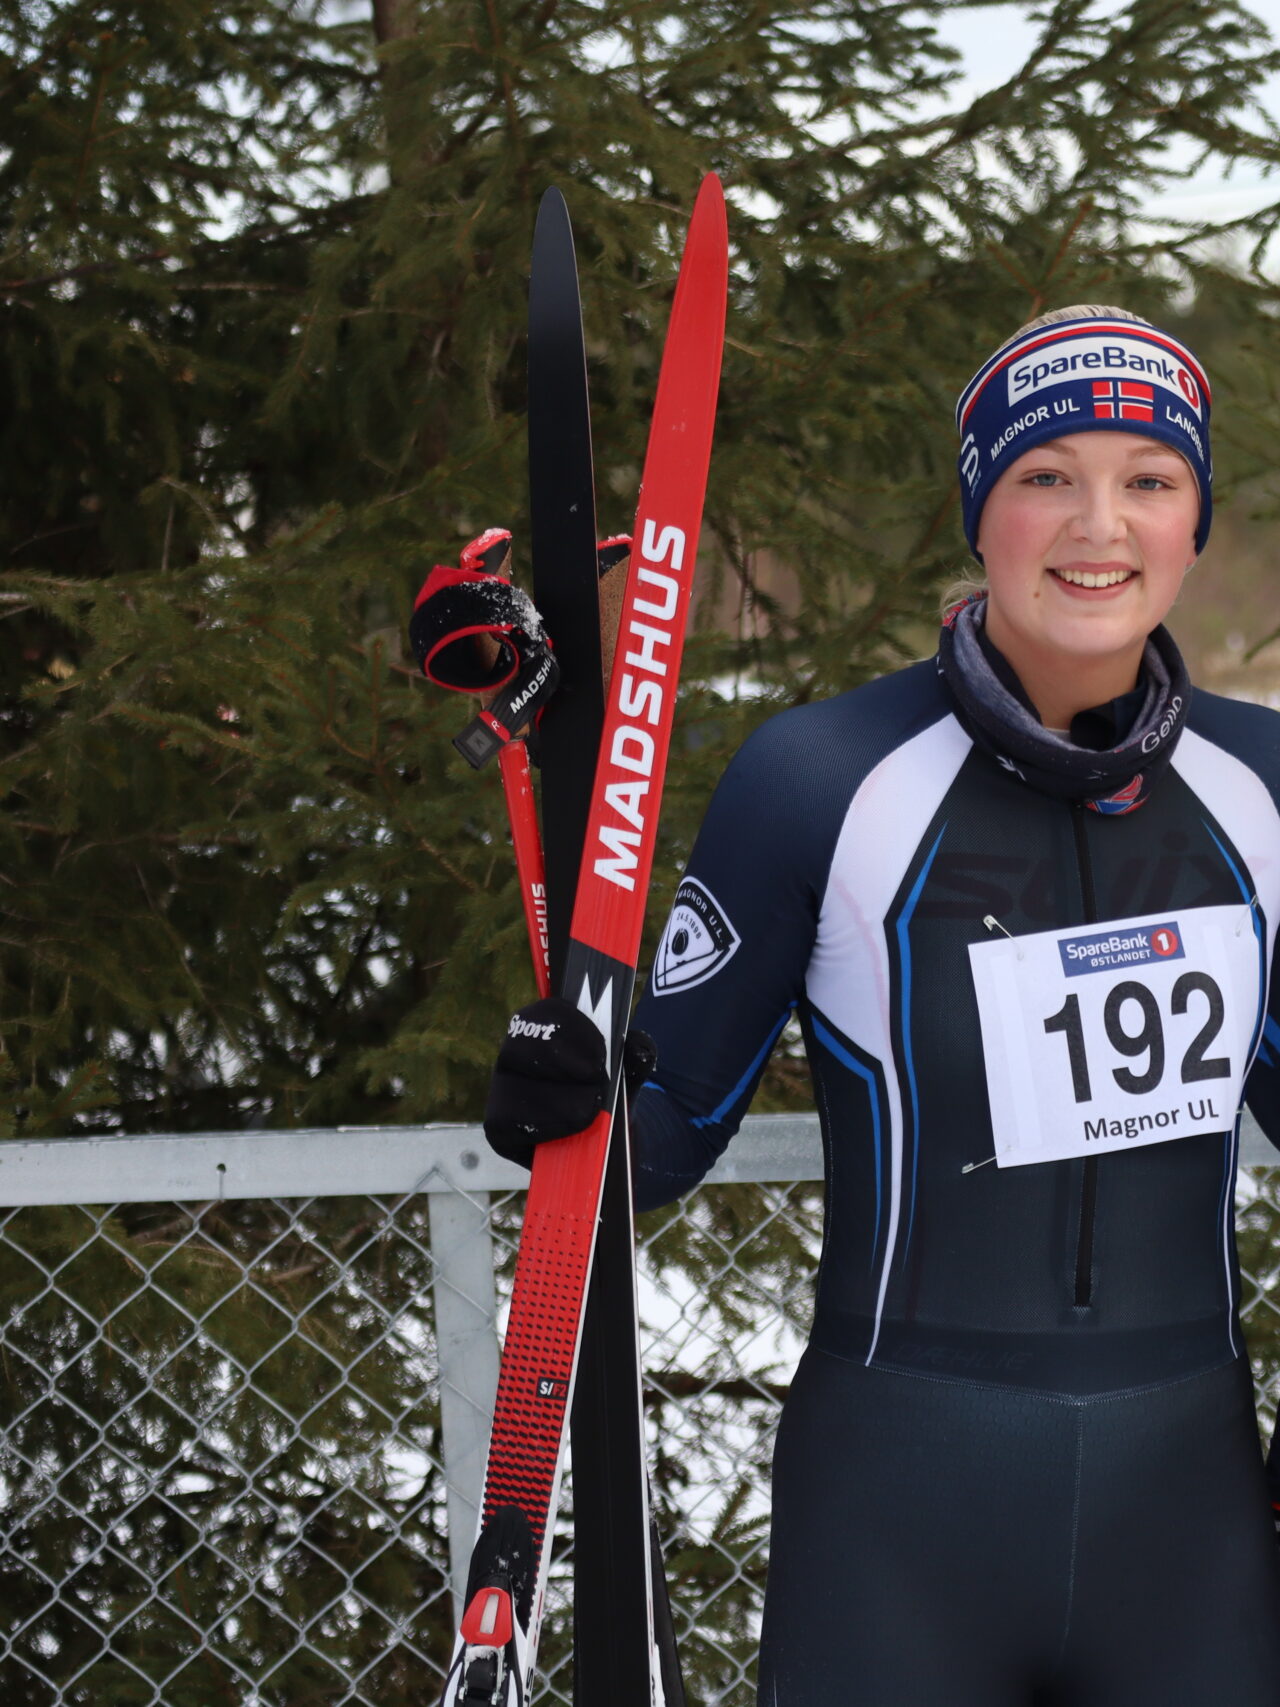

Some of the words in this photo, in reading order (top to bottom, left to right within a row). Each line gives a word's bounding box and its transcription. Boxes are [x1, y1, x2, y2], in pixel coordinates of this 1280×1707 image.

[1013, 346, 1177, 393] SpareBank
[990, 406, 1051, 462] MAGNOR
[1054, 398, 1081, 415] UL
[592, 517, 687, 893] MADSHUS
[1066, 933, 1149, 961] SpareBank
[1090, 950, 1151, 968] ØSTLANDET
[1043, 971, 1231, 1104] 192
[1083, 1107, 1180, 1141] Magnor
[1187, 1098, 1219, 1122] UL
